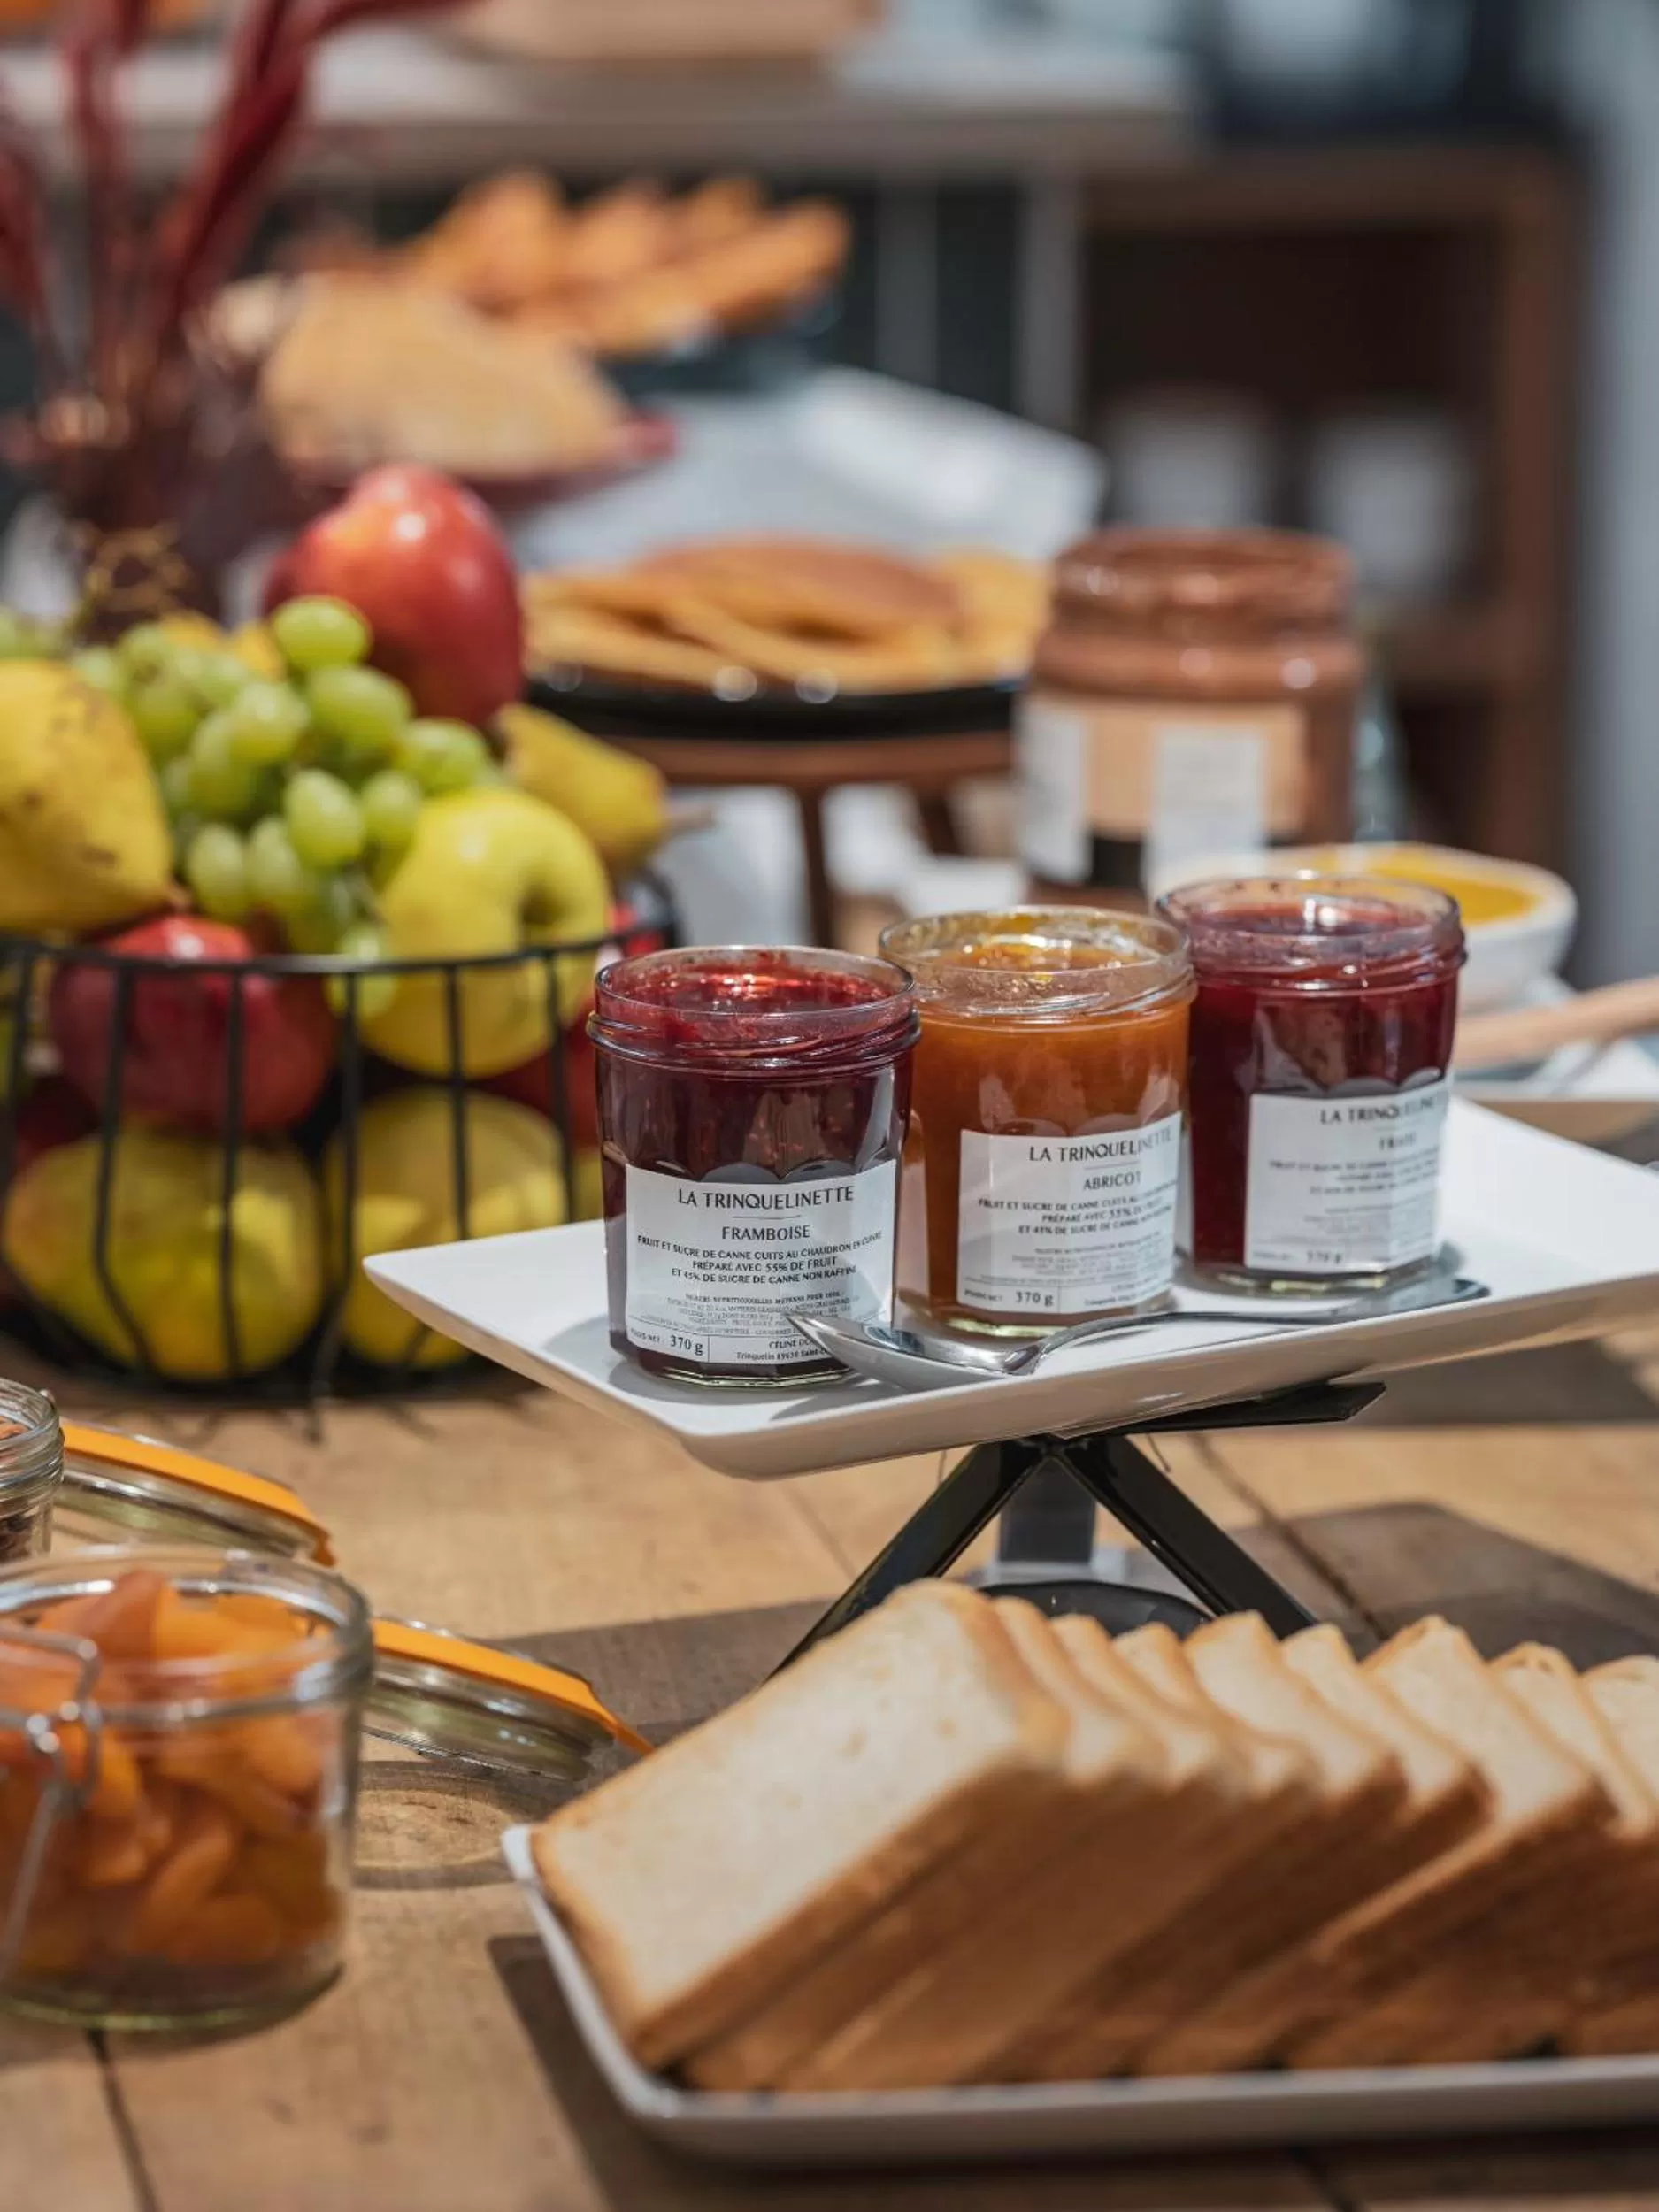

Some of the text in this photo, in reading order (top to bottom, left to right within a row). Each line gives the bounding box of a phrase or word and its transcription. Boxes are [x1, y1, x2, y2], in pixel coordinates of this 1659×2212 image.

[1319, 1107, 1342, 1125] LA
[1029, 1145, 1052, 1162] LA
[1083, 1170, 1141, 1191] ABRICOT
[678, 1184, 856, 1210] LA TRINQUELINETTE
[721, 1225, 811, 1241] FRAMBOISE
[637, 1234, 660, 1248] FRUIT
[661, 1240, 672, 1251] ET
[672, 1243, 700, 1258] SUCRE
[702, 1248, 716, 1259] DE
[717, 1249, 752, 1260] CANNE
[754, 1250, 785, 1260] CUITS
[786, 1249, 799, 1259] AU
[800, 1242, 852, 1257] CHAUDRON
[734, 1262, 762, 1272] AVEC
[764, 1262, 788, 1273] 55%
[789, 1260, 805, 1271] DE
[807, 1255, 839, 1270] FRUIT
[671, 1266, 682, 1278] ET
[702, 1272, 716, 1283] DE
[718, 1273, 751, 1284] SUCRE
[752, 1274, 766, 1284] DE
[767, 1272, 801, 1285] CANNE
[802, 1268, 823, 1281] NON
[1015, 1289, 1041, 1304] 370
[1044, 1294, 1055, 1308] g
[669, 1333, 693, 1351] 370
[694, 1341, 704, 1357] g
